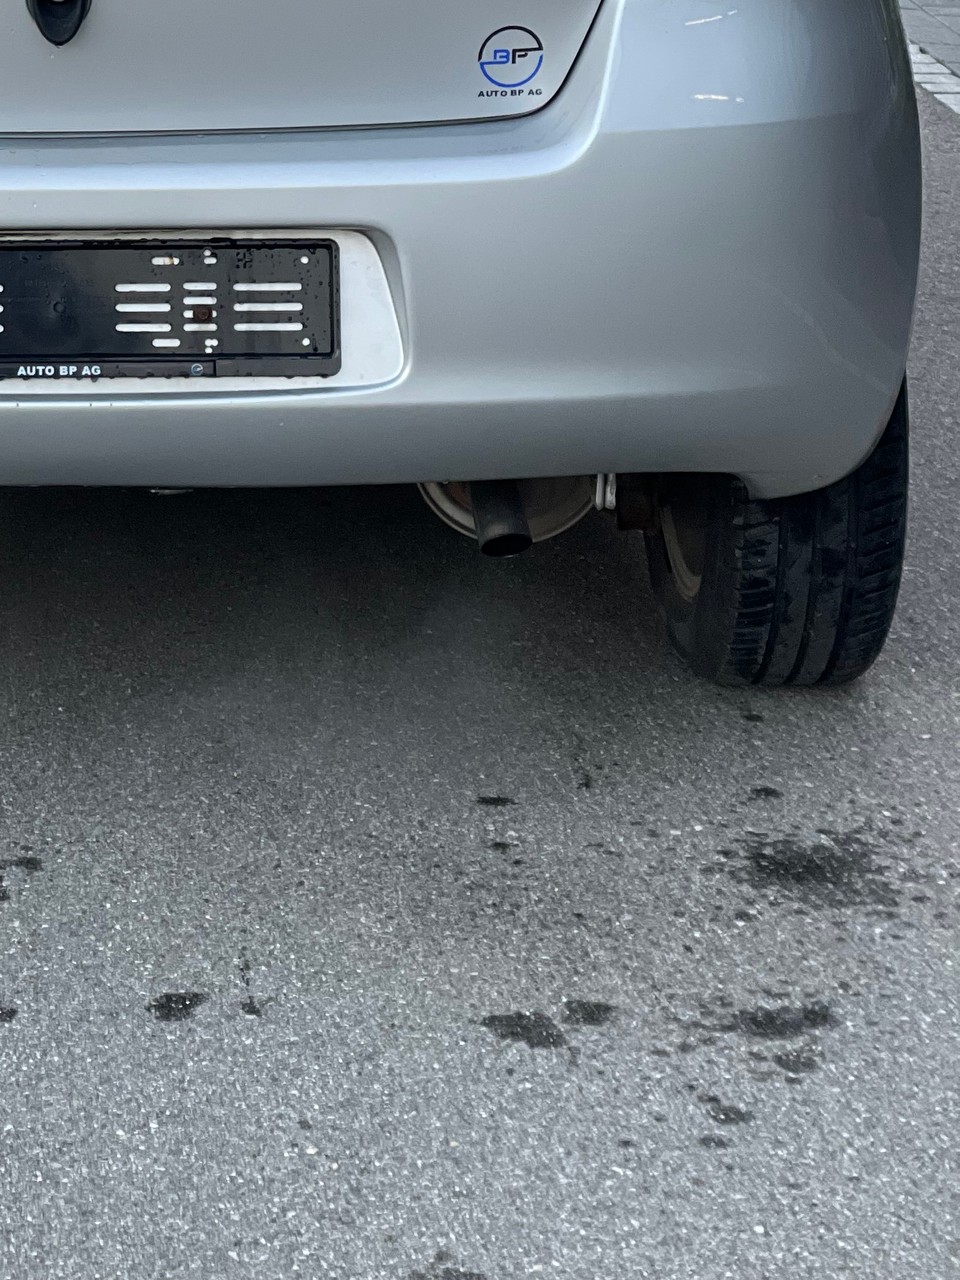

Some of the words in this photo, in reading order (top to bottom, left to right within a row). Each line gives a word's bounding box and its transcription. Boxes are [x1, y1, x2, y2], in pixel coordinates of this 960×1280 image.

[477, 90, 508, 98] AUTO
[510, 89, 525, 97] BP
[527, 88, 543, 96] AG
[17, 365, 55, 376] AUTO
[59, 365, 78, 376] BP
[81, 365, 101, 376] AG
